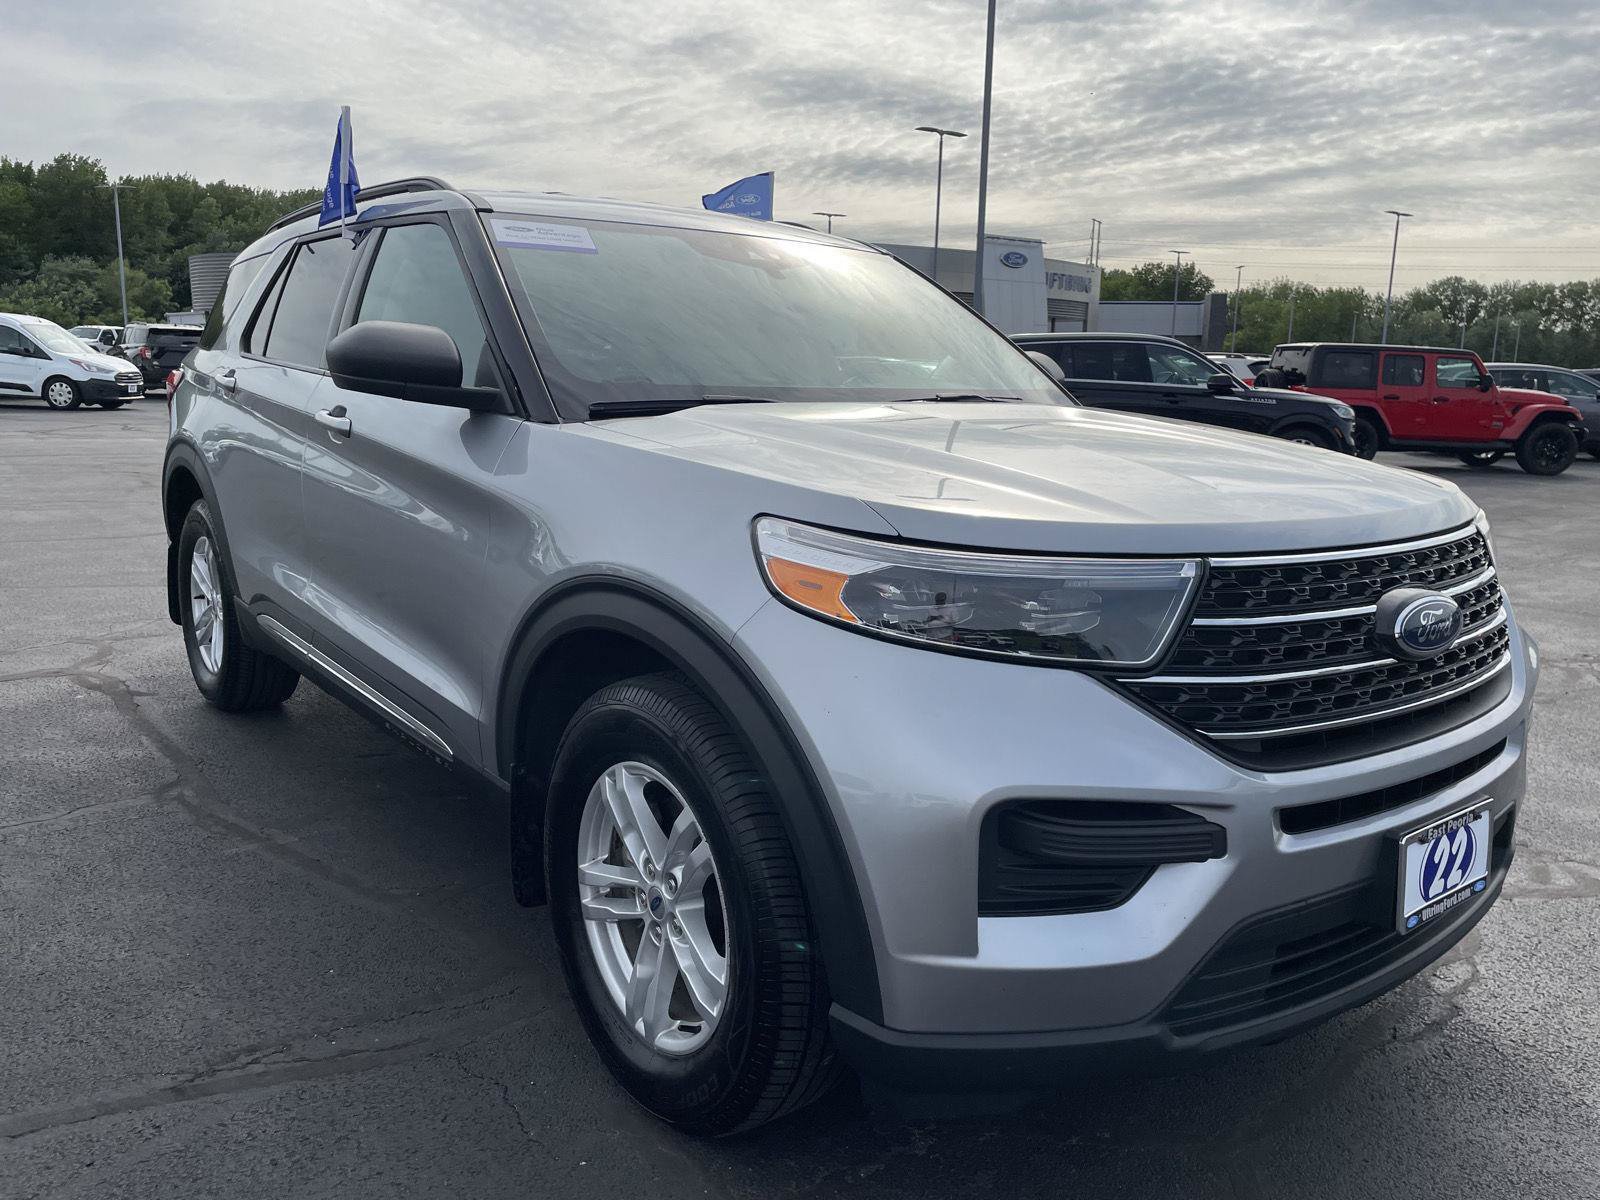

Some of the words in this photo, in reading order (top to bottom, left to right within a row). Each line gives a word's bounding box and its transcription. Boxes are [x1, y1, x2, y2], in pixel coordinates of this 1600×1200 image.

[1417, 608, 1453, 642] Ford
[1427, 825, 1447, 841] East
[1447, 813, 1474, 832] Peoria
[1428, 827, 1468, 898] 22
